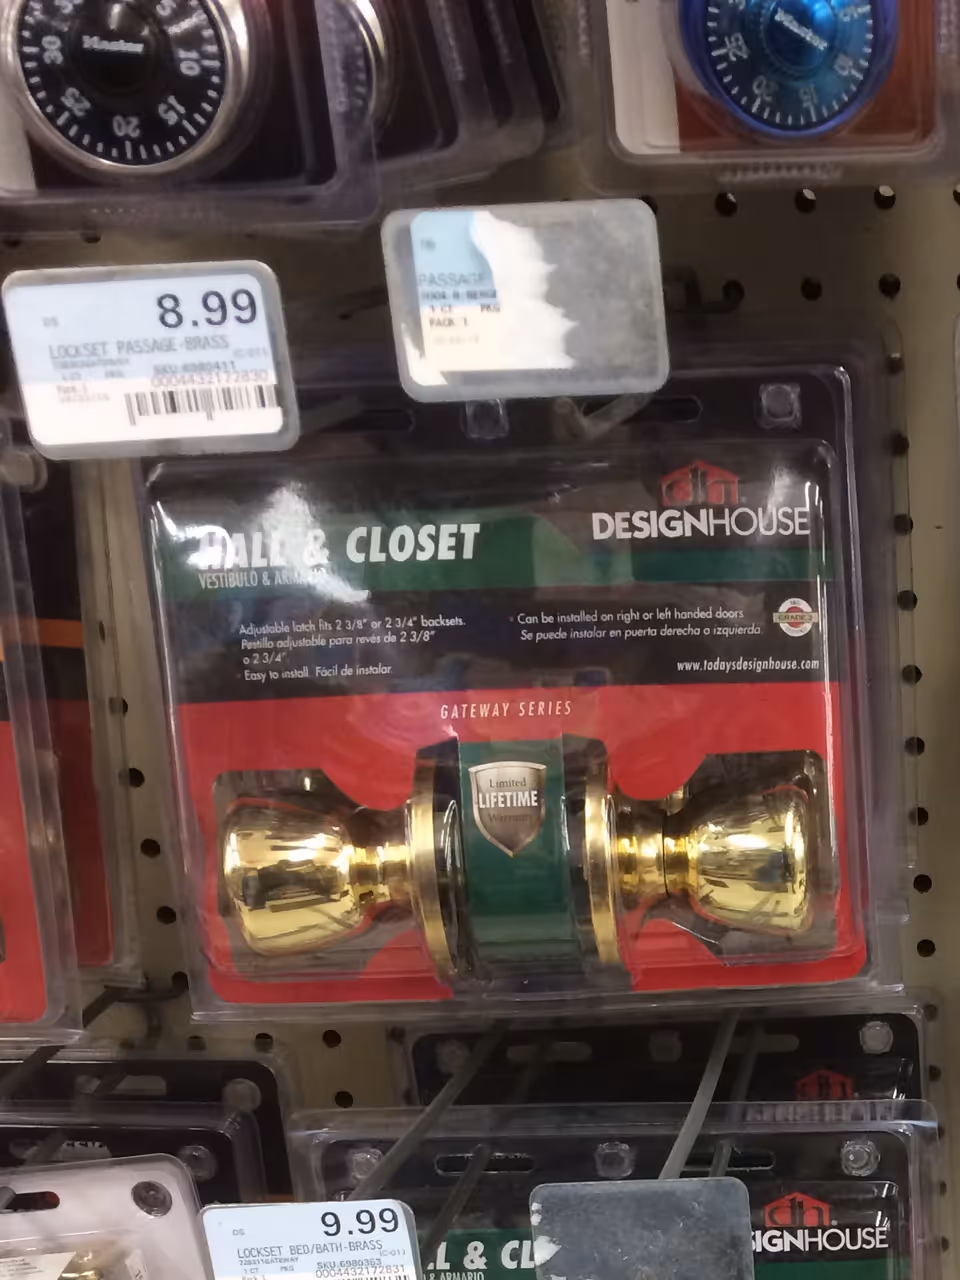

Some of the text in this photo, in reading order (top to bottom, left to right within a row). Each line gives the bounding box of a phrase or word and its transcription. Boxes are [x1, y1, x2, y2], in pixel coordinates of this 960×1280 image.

[155, 288, 258, 329] 8.99
[48, 335, 230, 360] LOCKSET PASSAGE-BRASS
[591, 505, 812, 541] DESIGNHOUSE
[346, 522, 481, 564] CLOSET
[238, 614, 467, 637] Adjustable latch fits 3/8" or 3/4" backsets.
[517, 612, 537, 625] Can
[540, 611, 555, 624] be
[557, 609, 598, 623] installed
[601, 612, 614, 622] on
[617, 607, 640, 623] right
[642, 611, 654, 620] or
[656, 607, 672, 620] left
[674, 606, 714, 620] handed
[240, 629, 436, 651] Pestillo adjustable para revés de 3/8"
[520, 628, 533, 641] Se
[535, 627, 568, 643] puede
[570, 626, 607, 640] instalar
[609, 628, 622, 638] en
[624, 625, 658, 641] puerta
[660, 624, 701, 638] derecha
[244, 669, 267, 684] Easy
[315, 664, 338, 678] Fácil
[340, 664, 354, 676] de
[676, 656, 820, 674] www.todaysdesignhouse.com
[440, 699, 572, 719] GATEWAY SERIES
[489, 777, 527, 790] Limited
[478, 790, 539, 810] LIFETIME
[320, 1207, 400, 1237] 9.99
[237, 1239, 384, 1259] LOCKSET BED/BATH-BRASS
[315, 1264, 406, 1279] 0004432172831
